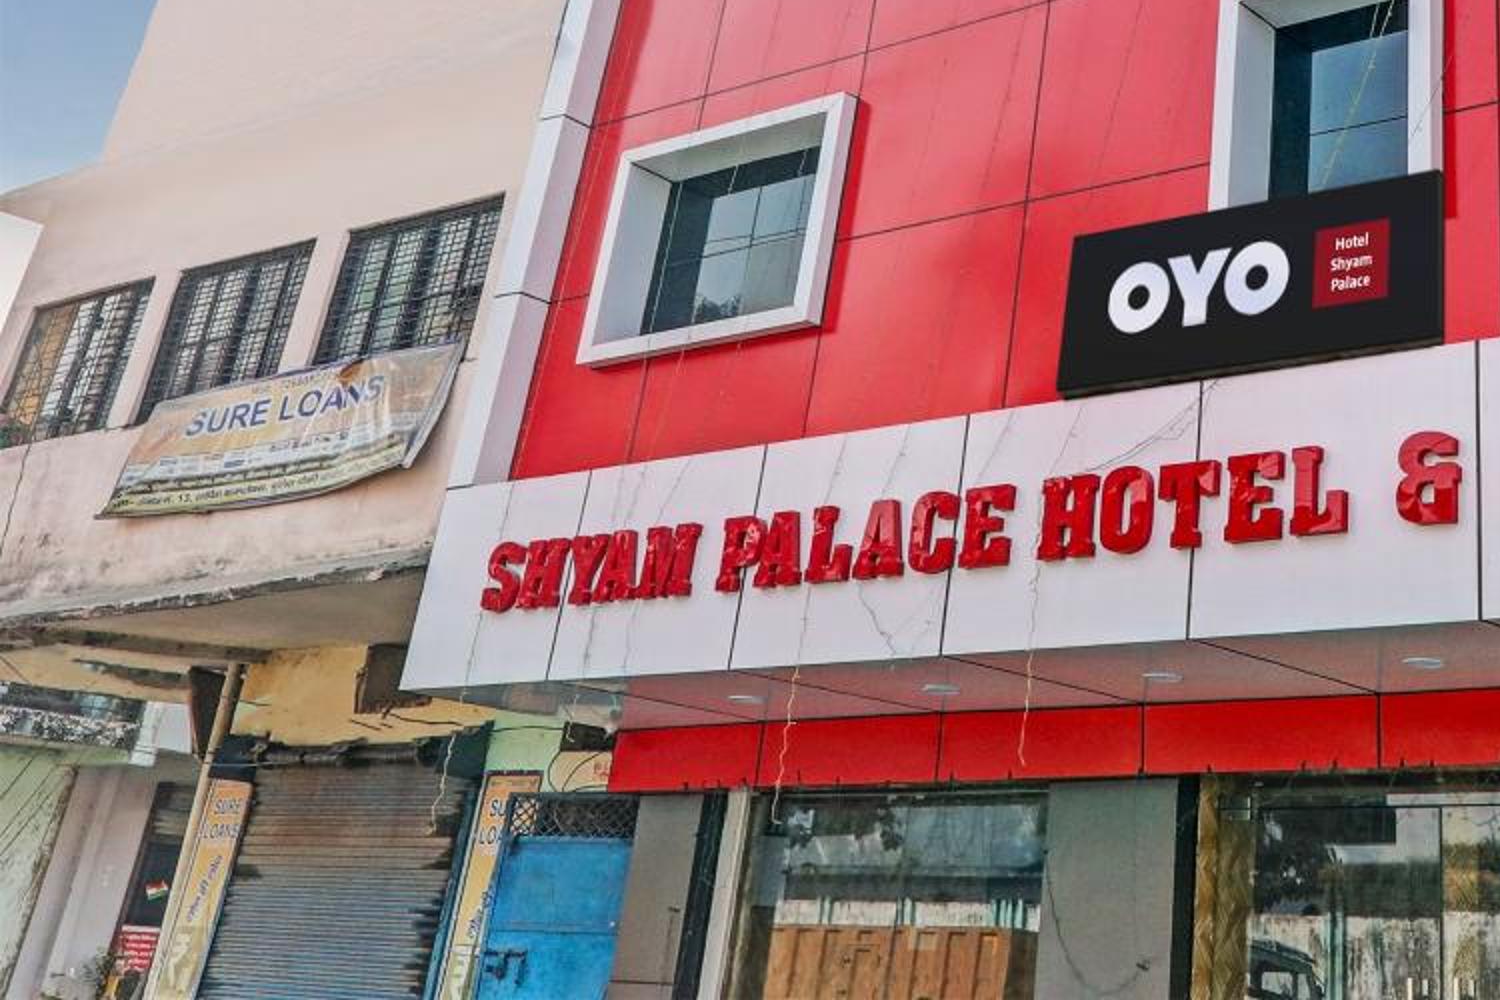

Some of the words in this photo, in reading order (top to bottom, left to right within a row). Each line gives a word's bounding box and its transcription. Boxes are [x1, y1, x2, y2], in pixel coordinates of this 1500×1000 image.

[1334, 232, 1370, 251] Hotel
[1330, 252, 1373, 273] Shyam
[1330, 273, 1371, 292] Palace
[1107, 240, 1291, 334] OYO
[185, 399, 271, 436] SURE
[278, 375, 384, 420] LOANS
[480, 522, 703, 613] SHYAM
[715, 481, 1017, 592] PALACE
[1036, 445, 1350, 562] HOTEL
[1395, 430, 1463, 527] &
